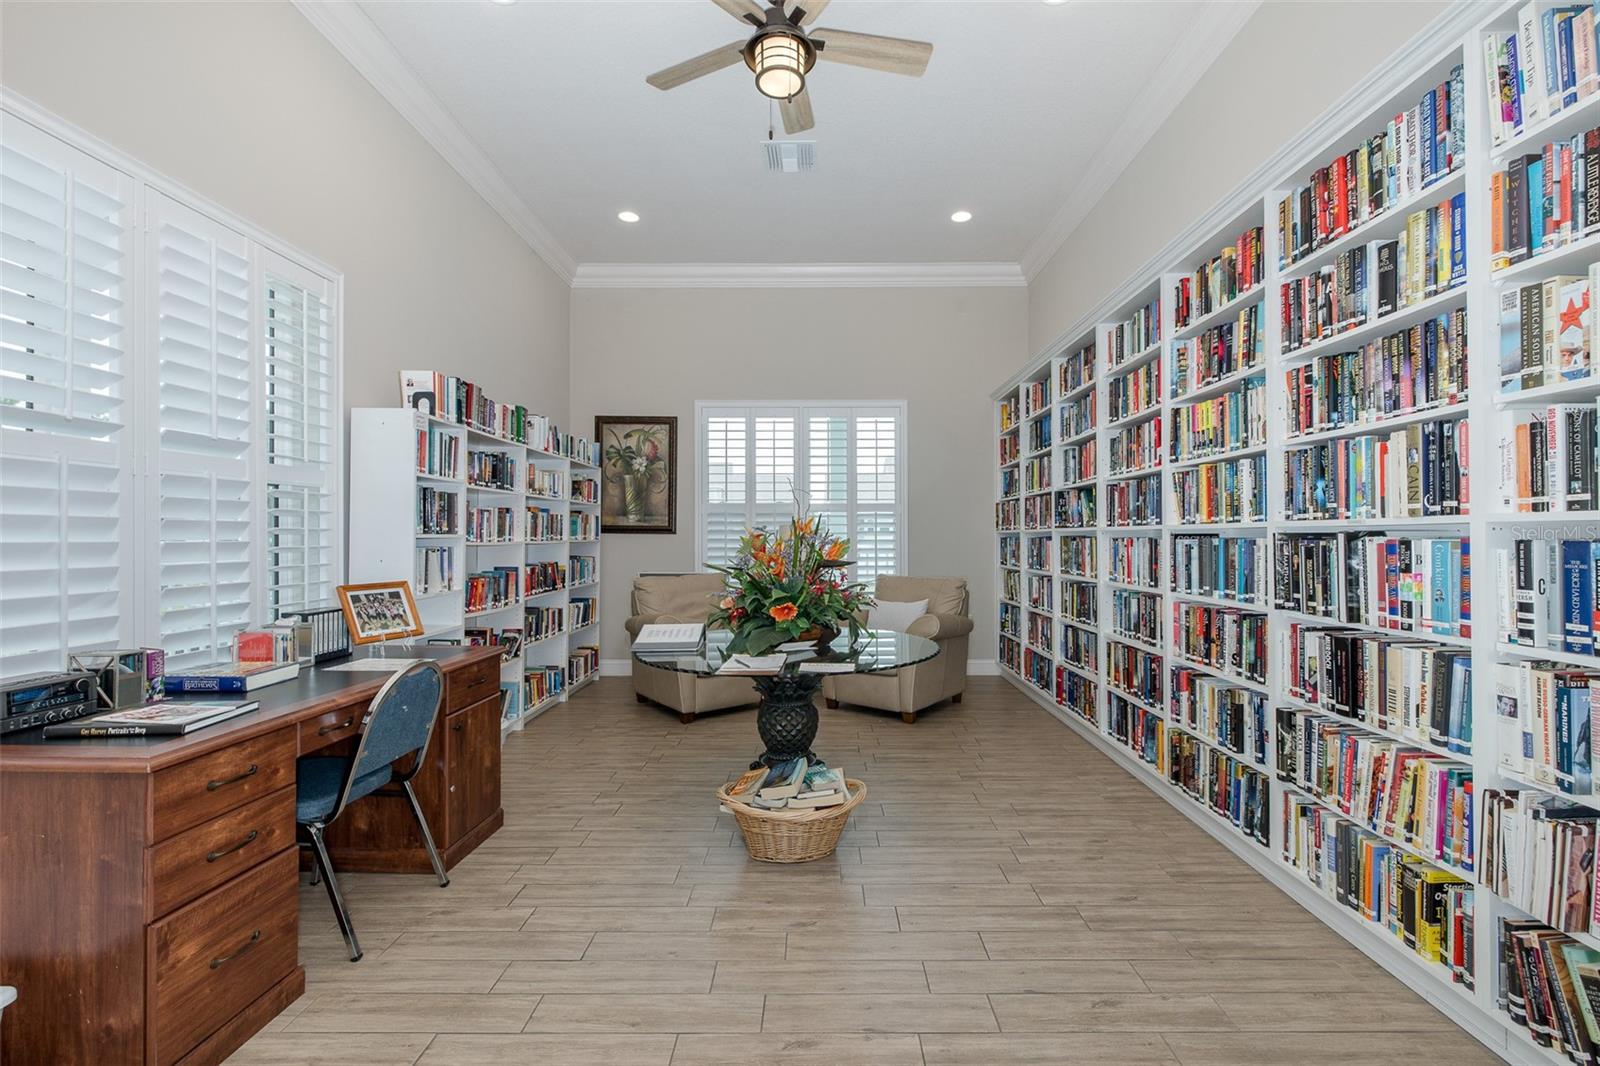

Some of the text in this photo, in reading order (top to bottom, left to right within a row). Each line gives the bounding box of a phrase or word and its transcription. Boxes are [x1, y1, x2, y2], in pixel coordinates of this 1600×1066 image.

[1526, 64, 1535, 88] Tips
[1588, 188, 1600, 224] REVENGE
[1532, 290, 1540, 376] AMERICAN SOLDIR
[1574, 434, 1581, 443] OF
[1409, 465, 1419, 500] CAIN
[1436, 545, 1444, 585] Cronkite
[1572, 573, 1580, 635] RICHARD NIXN
